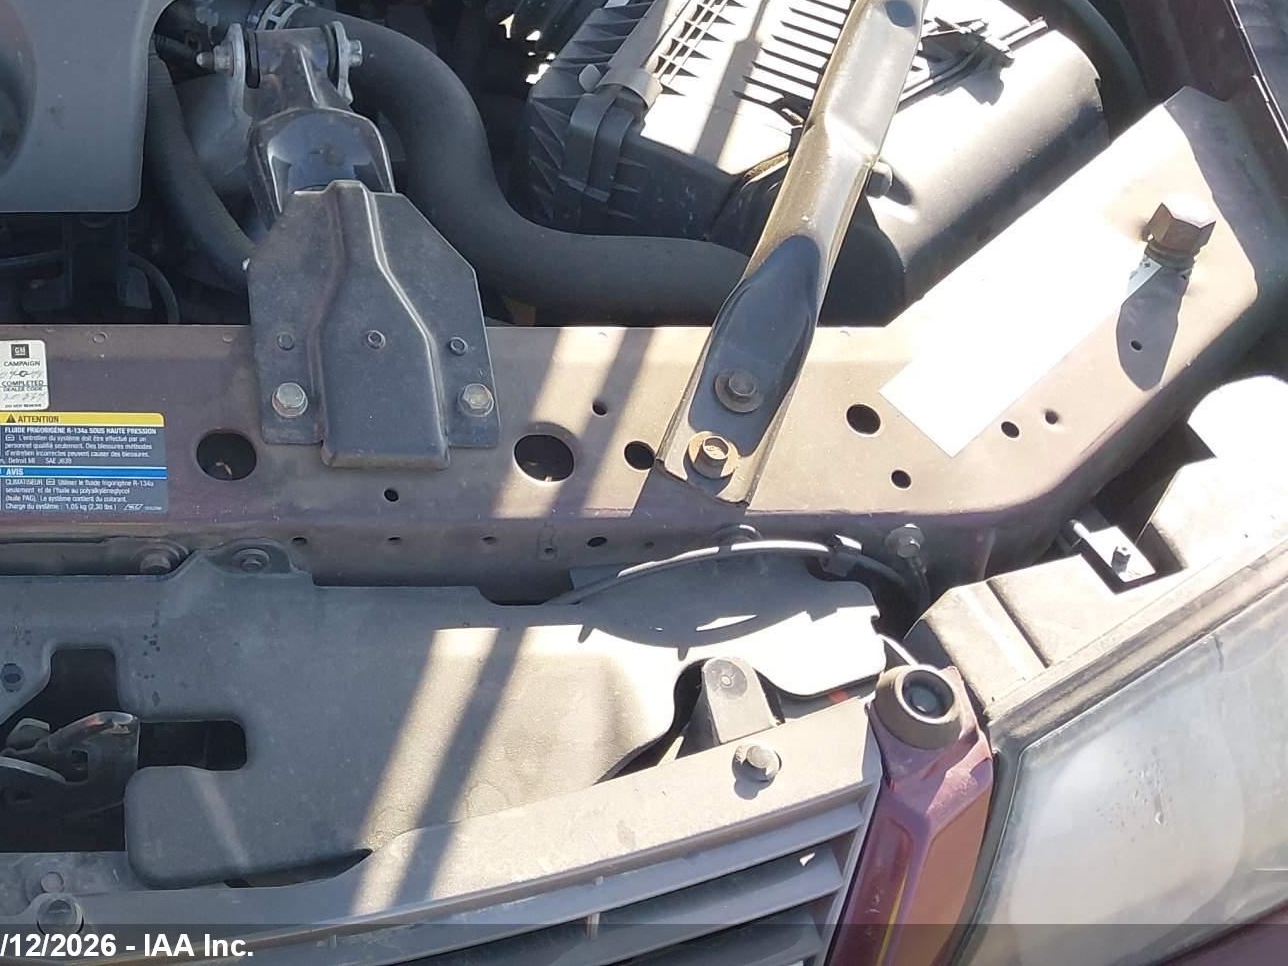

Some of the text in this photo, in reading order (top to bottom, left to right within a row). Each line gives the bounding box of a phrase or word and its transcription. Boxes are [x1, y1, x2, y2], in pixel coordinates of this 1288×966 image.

[17, 415, 59, 423] ATTENTION
[8, 457, 27, 465] Detroit
[45, 457, 56, 465] SAE
[6, 468, 24, 476] AVIS
[80, 503, 87, 511] kg
